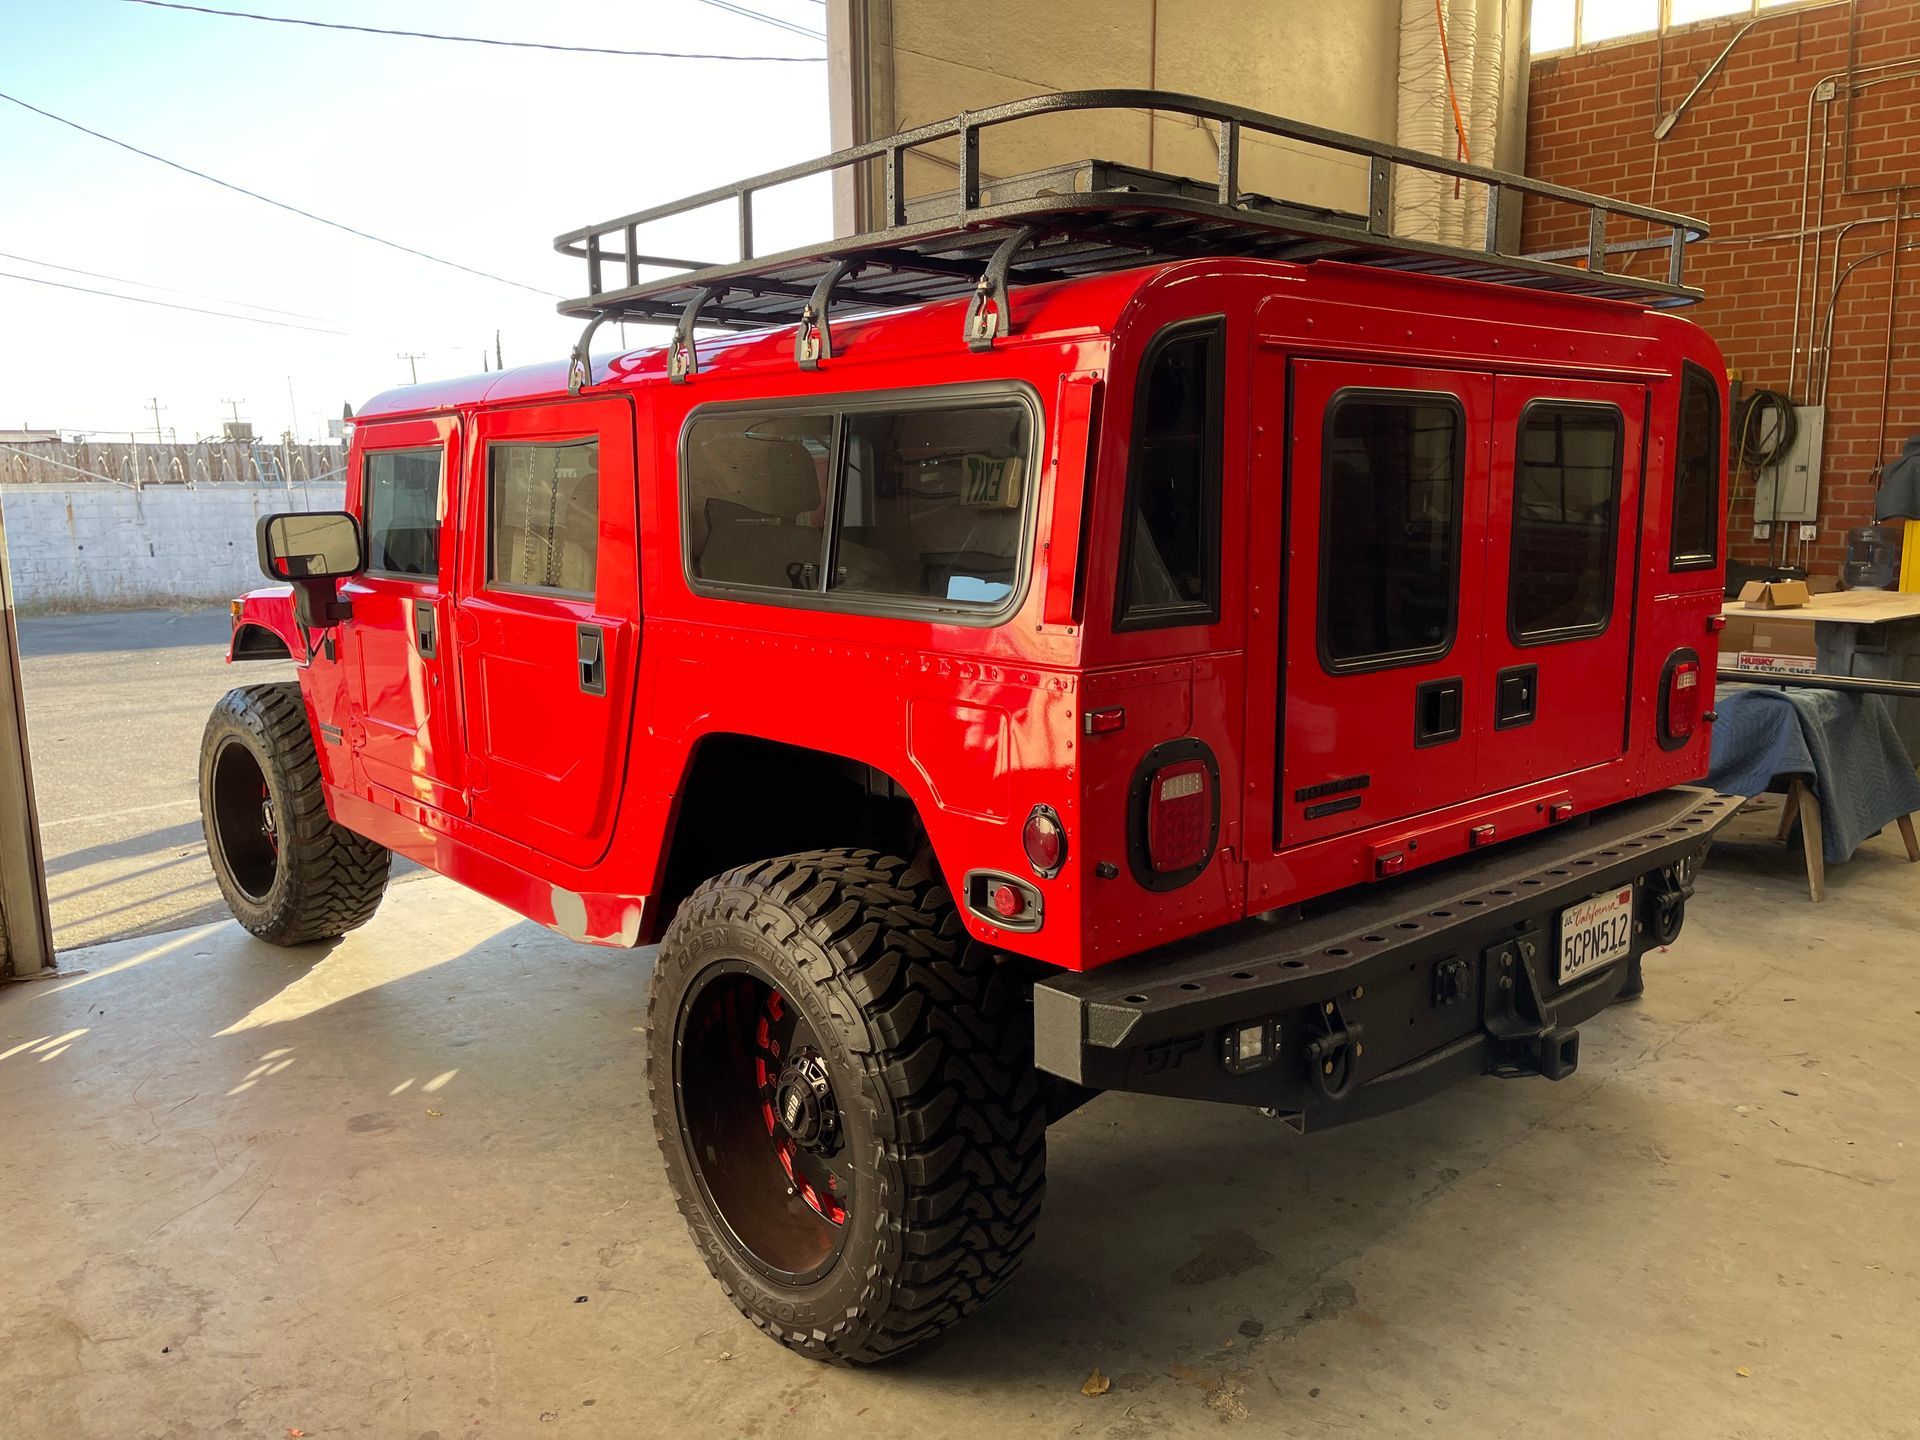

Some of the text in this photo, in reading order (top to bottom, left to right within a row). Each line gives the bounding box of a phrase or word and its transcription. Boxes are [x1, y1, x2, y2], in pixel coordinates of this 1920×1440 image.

[1741, 657, 1774, 666] HUSKY
[677, 927, 730, 970] OPEN
[1564, 912, 1629, 972] 5CPN512
[737, 1277, 816, 1323] TOYO
